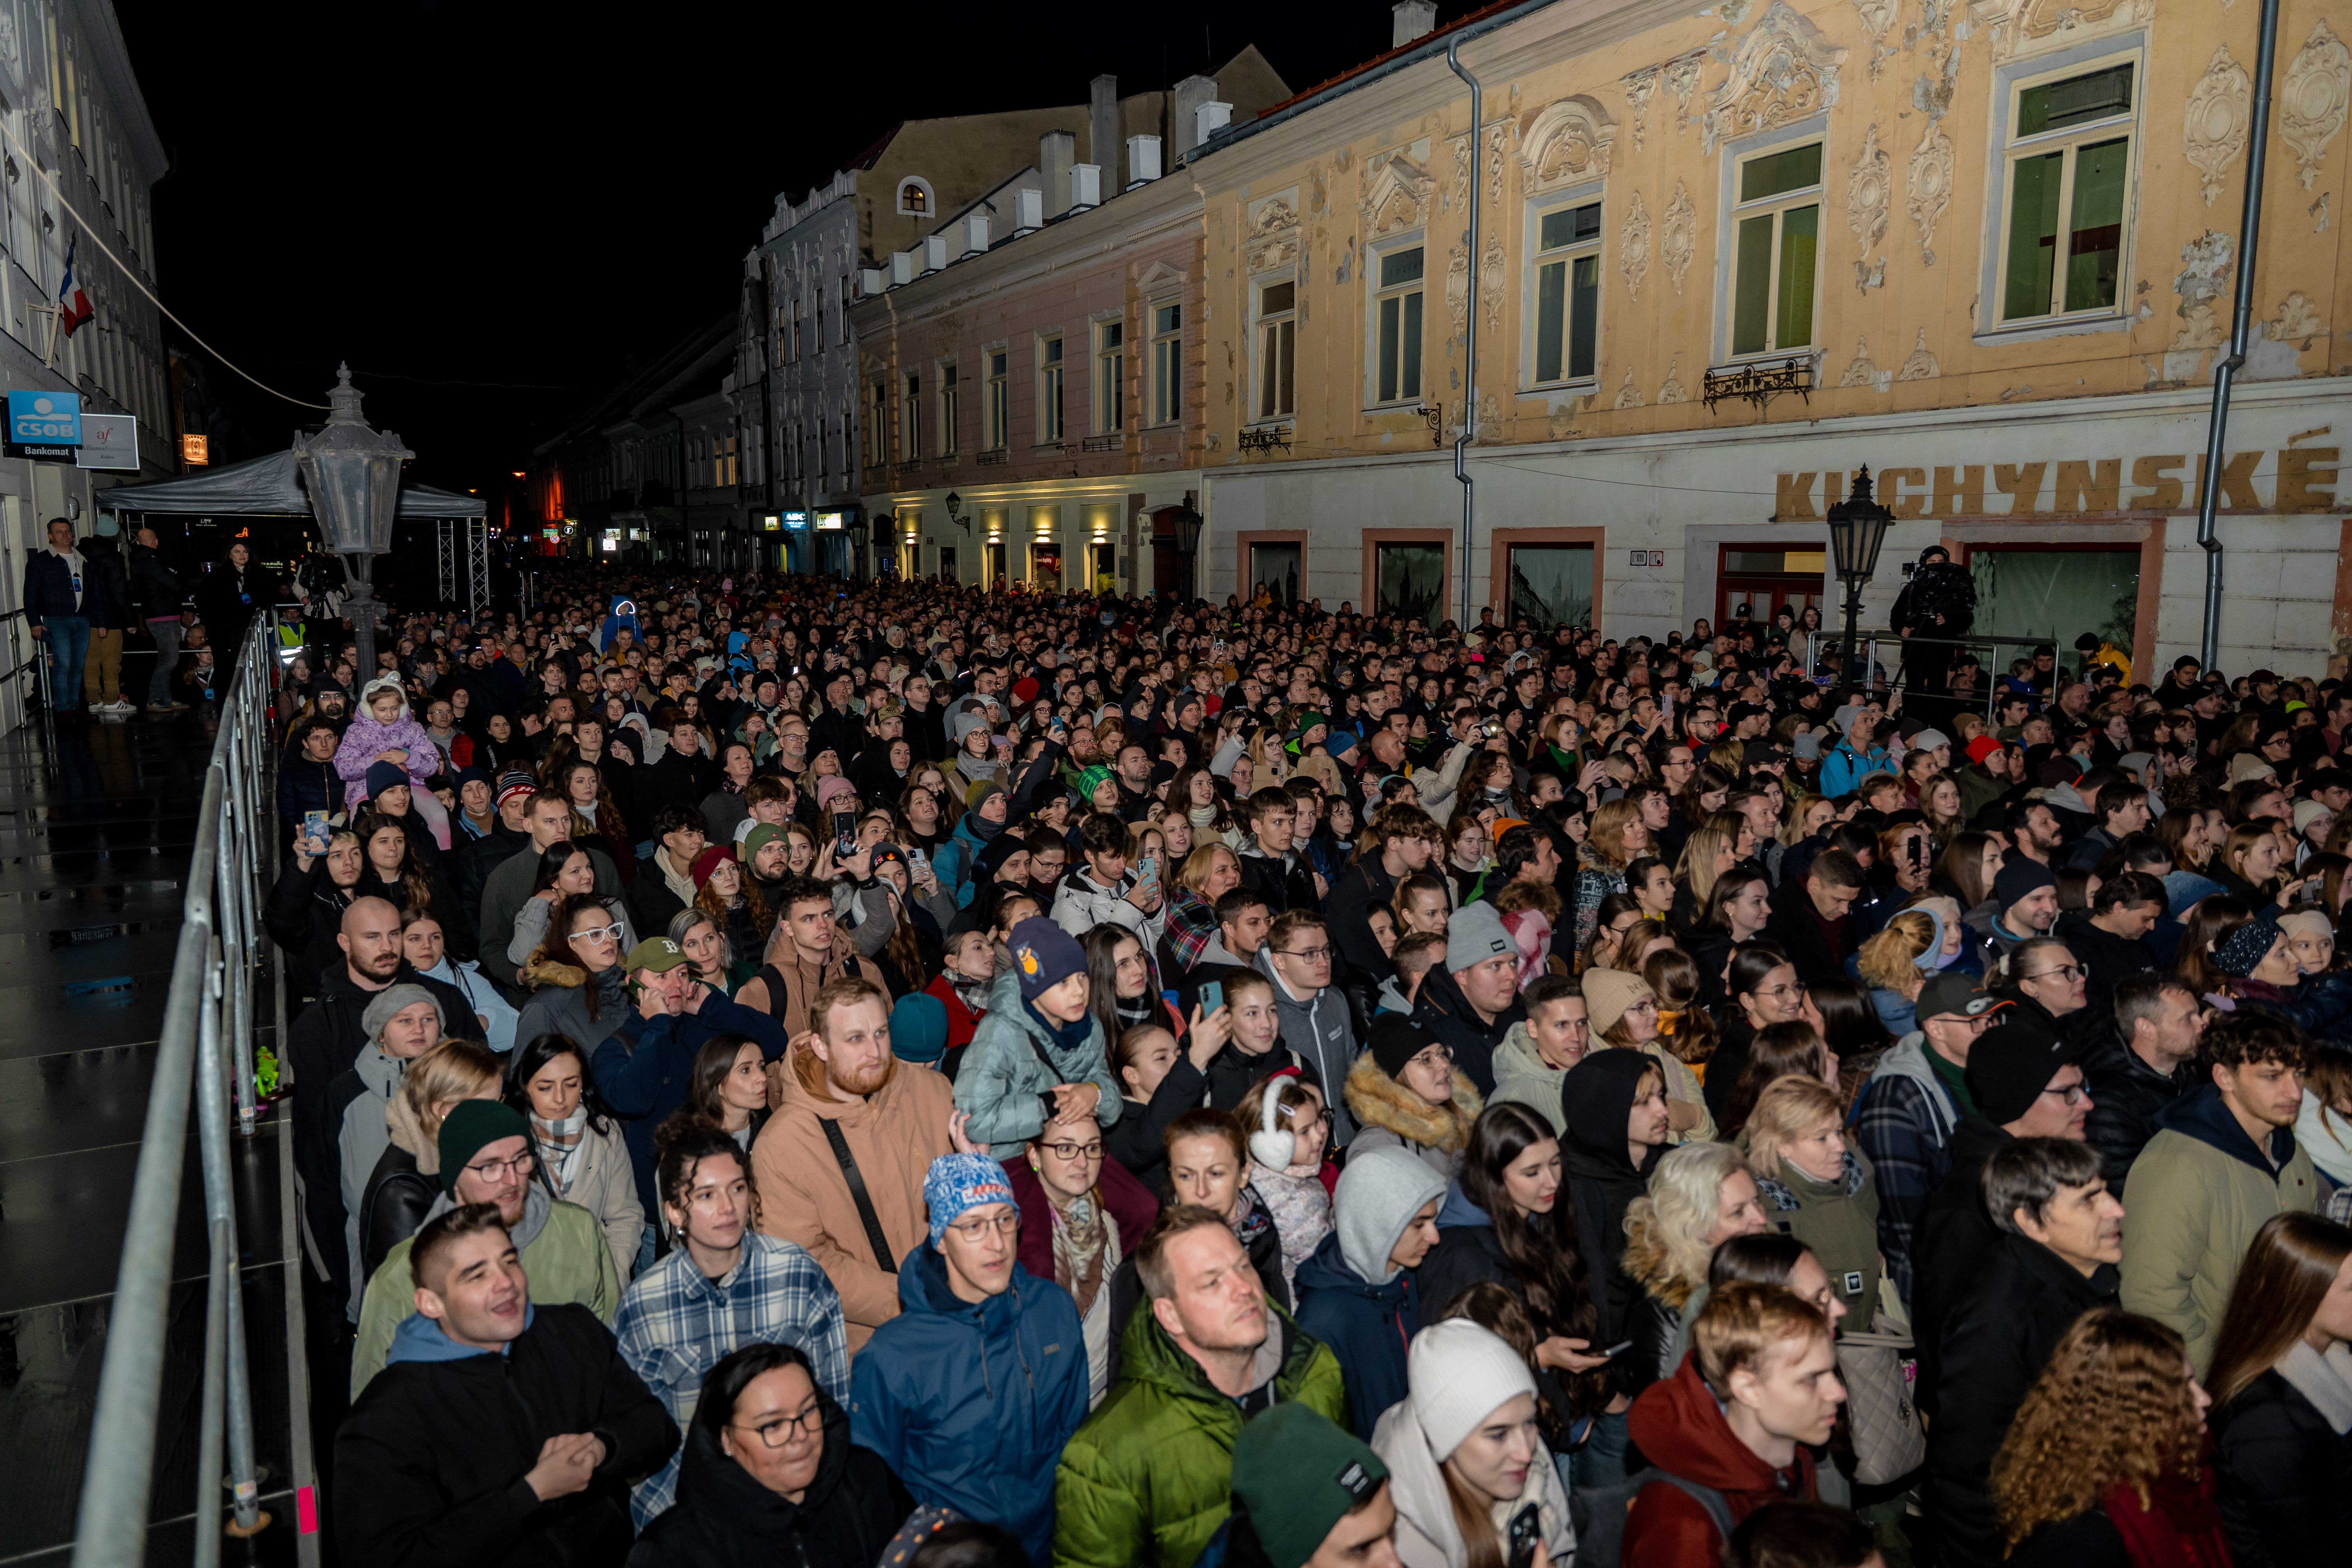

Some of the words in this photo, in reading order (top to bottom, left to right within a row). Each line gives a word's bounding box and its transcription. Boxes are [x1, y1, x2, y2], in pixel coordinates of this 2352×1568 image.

[17, 421, 74, 437] ČSOB
[97, 427, 113, 444] af
[25, 446, 69, 456] Bankomat
[1775, 425, 2339, 517] KUCHYNSKÉ
[818, 516, 826, 526] ABC
[1654, 554, 1657, 563] 1
[662, 940, 679, 953] B
